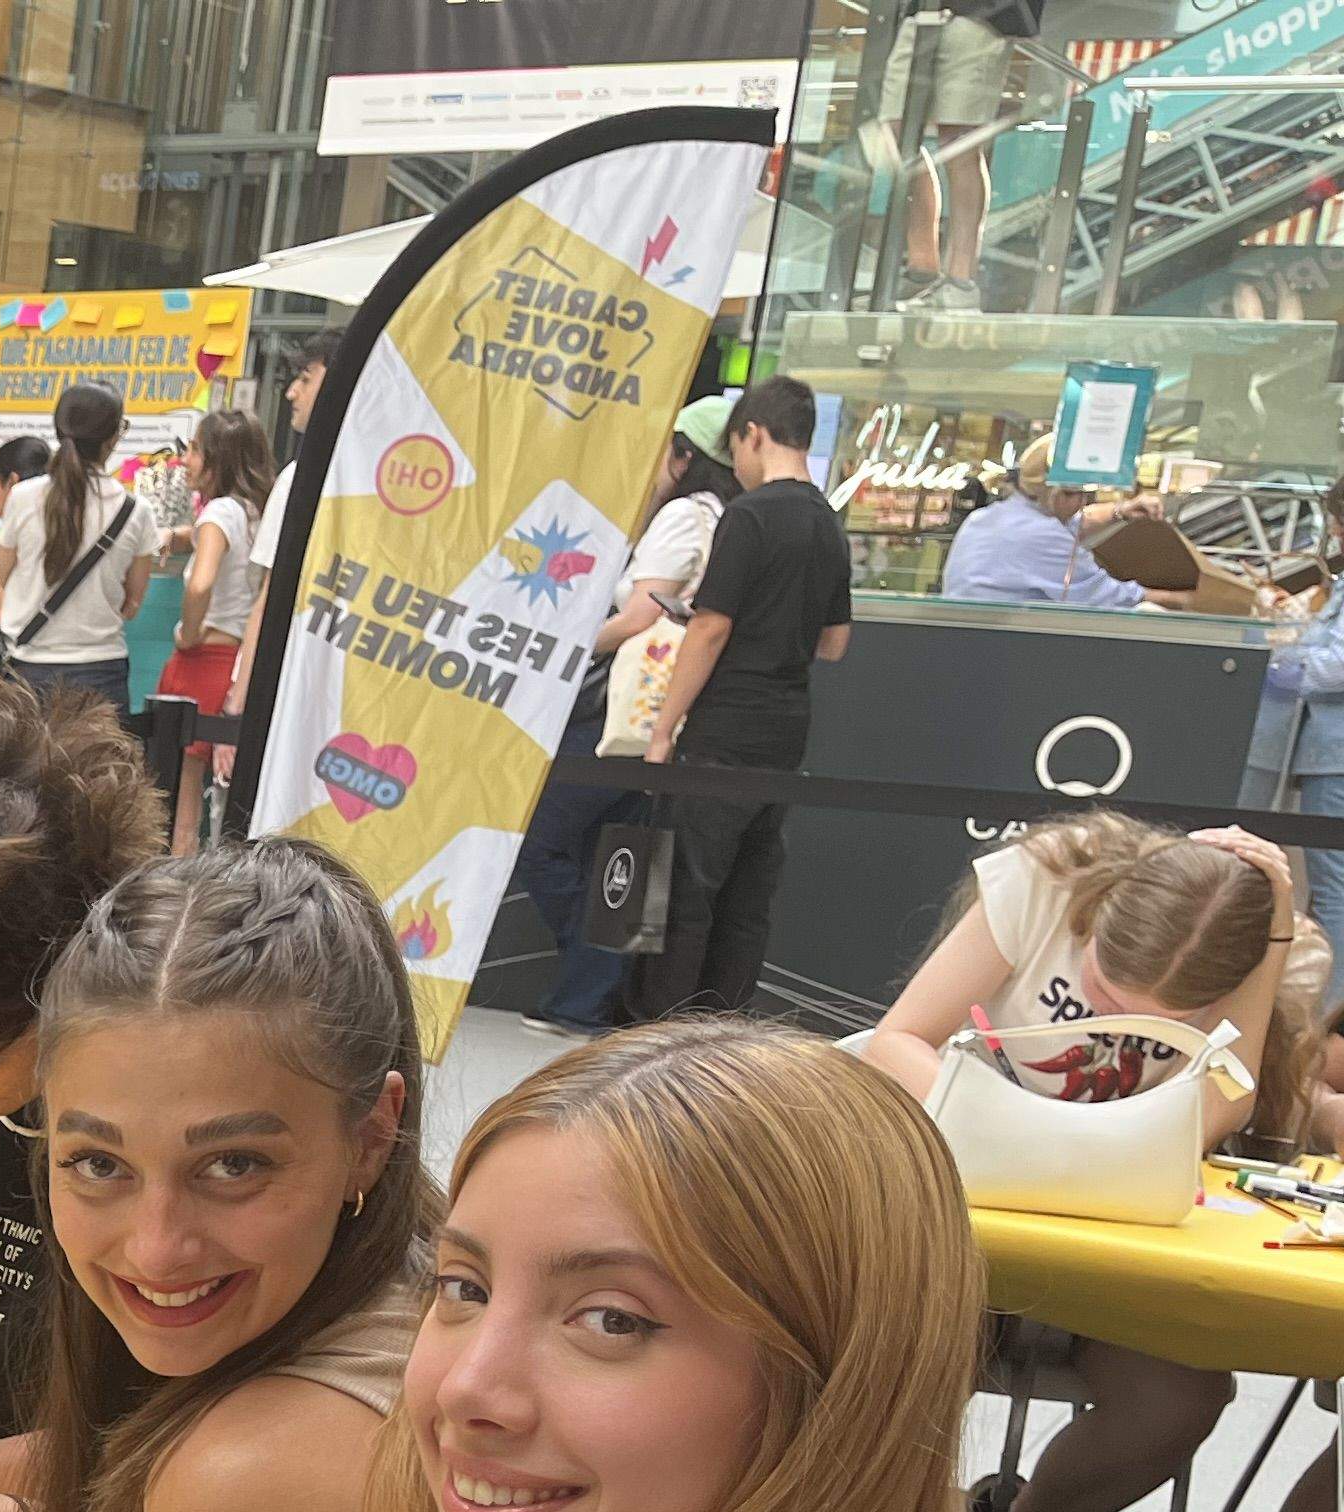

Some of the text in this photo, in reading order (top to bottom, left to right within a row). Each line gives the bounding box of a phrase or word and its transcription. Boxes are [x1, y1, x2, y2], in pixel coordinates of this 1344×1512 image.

[1205, 0, 1344, 74] shopp
[168, 335, 192, 366] DE
[3, 1243, 24, 1262] OF
